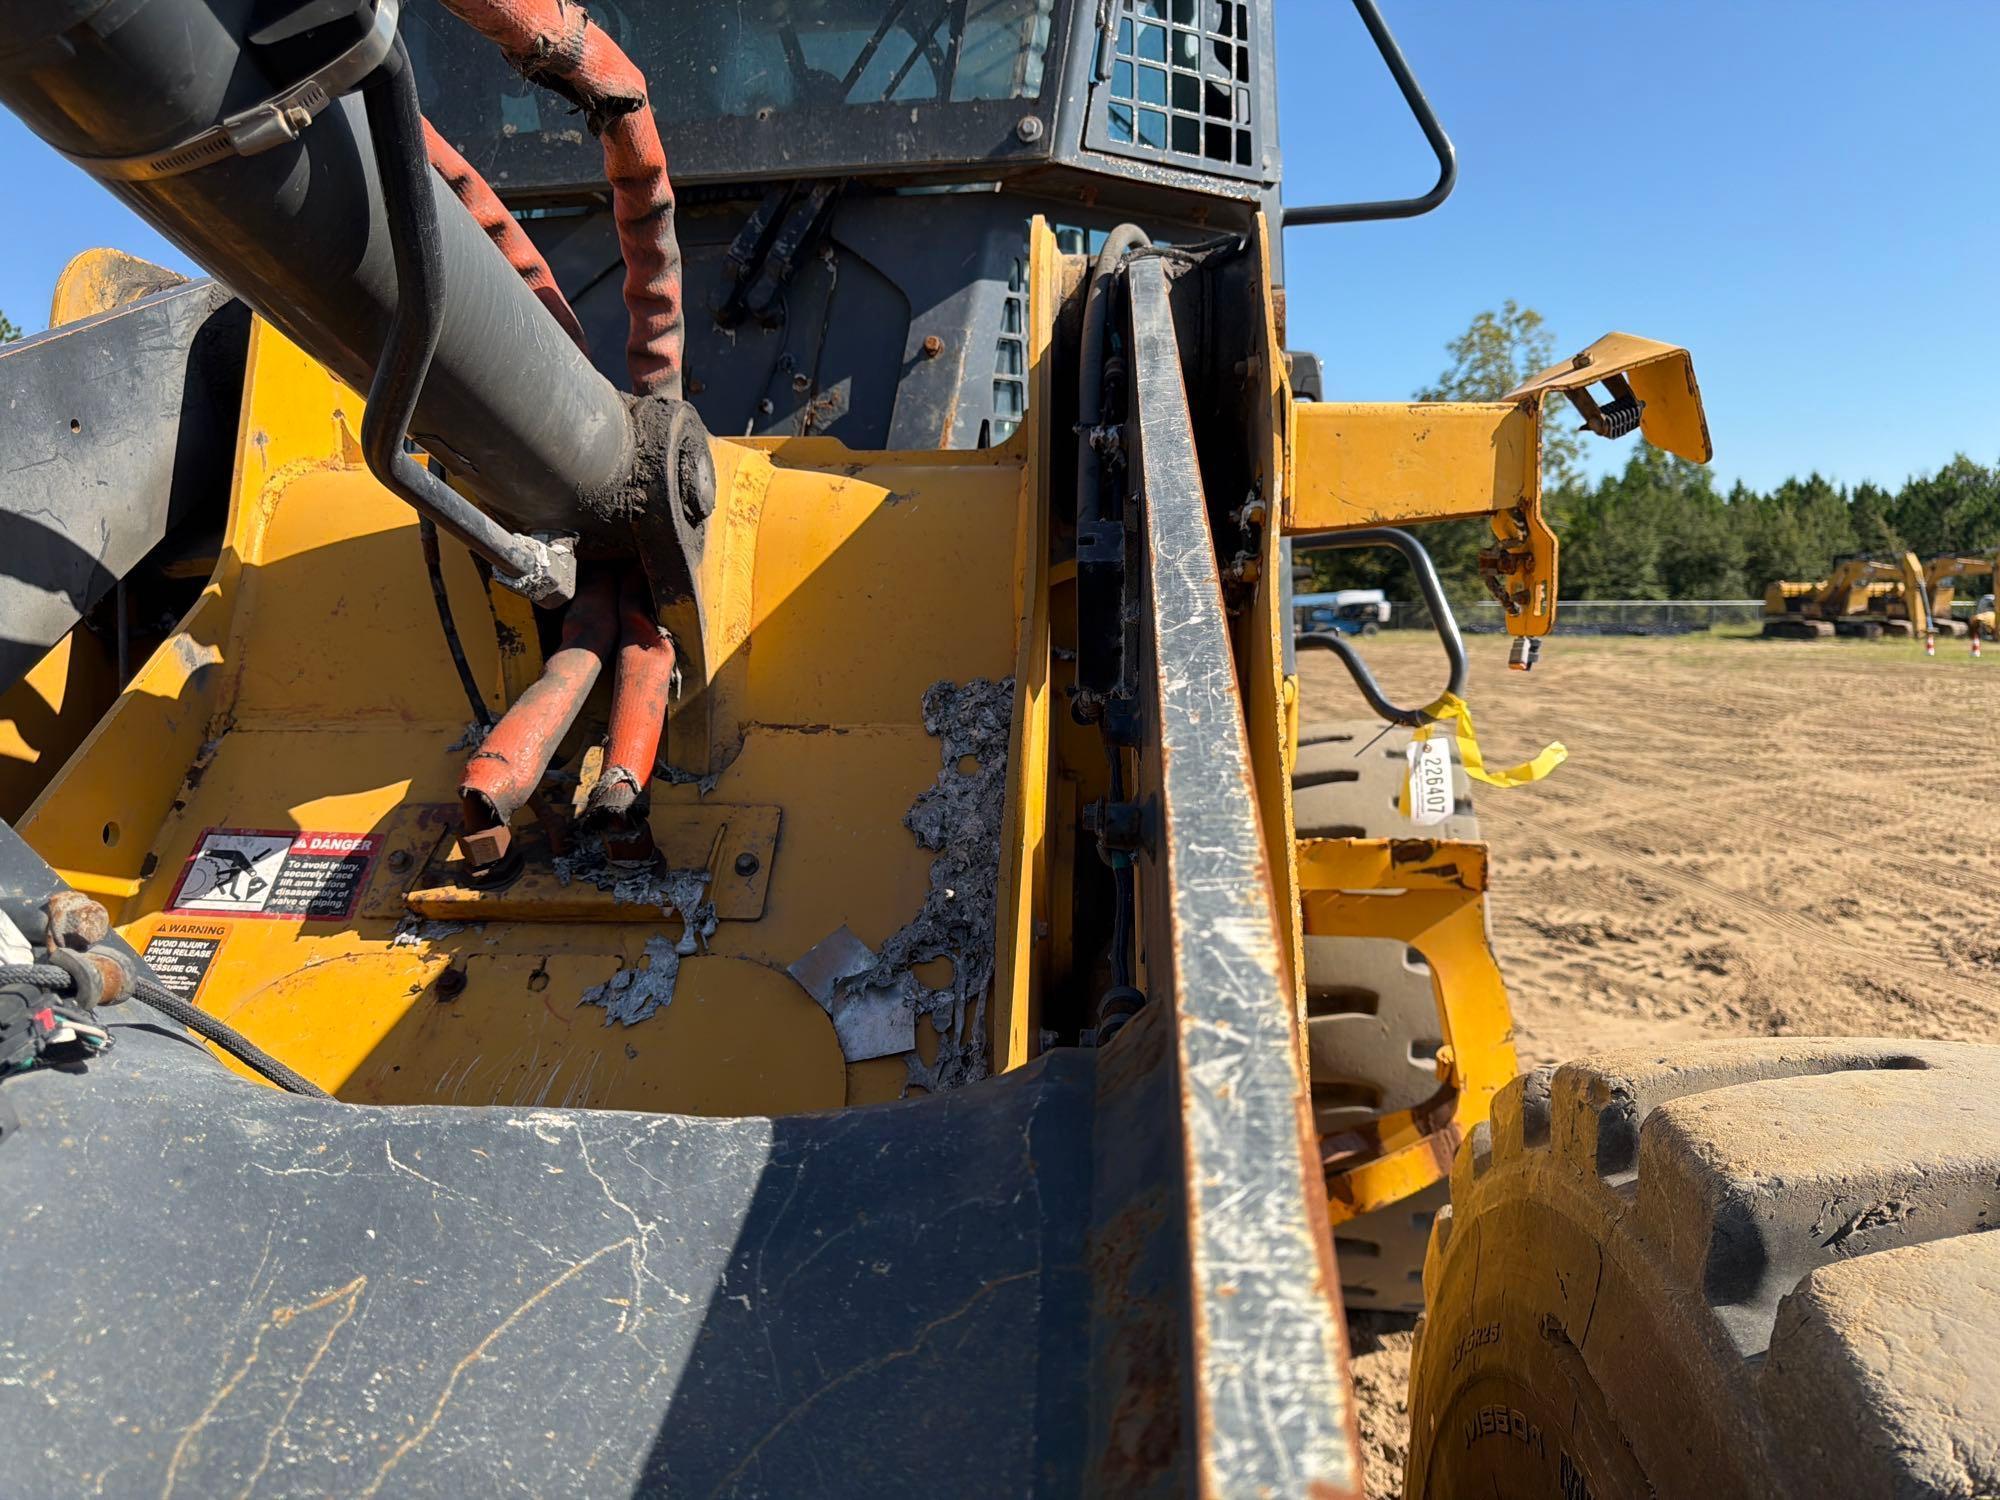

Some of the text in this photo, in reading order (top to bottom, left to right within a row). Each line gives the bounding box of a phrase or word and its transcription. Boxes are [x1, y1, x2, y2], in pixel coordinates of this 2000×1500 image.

[1424, 757, 1445, 814] 226407
[309, 838, 372, 850] DANGER
[288, 860, 360, 871] To avoid injury,
[283, 870, 353, 880] securely brace
[279, 879, 294, 887] lift
[314, 880, 346, 888] before
[275, 888, 349, 898] disassembly of
[271, 897, 344, 909] valve or piping.
[169, 924, 225, 935] WARNING
[150, 939, 210, 950] AVOID INJURY
[147, 947, 212, 958] FROM RELEASE
[144, 955, 179, 964] OF HIGH
[148, 963, 185, 973] ESSURE
